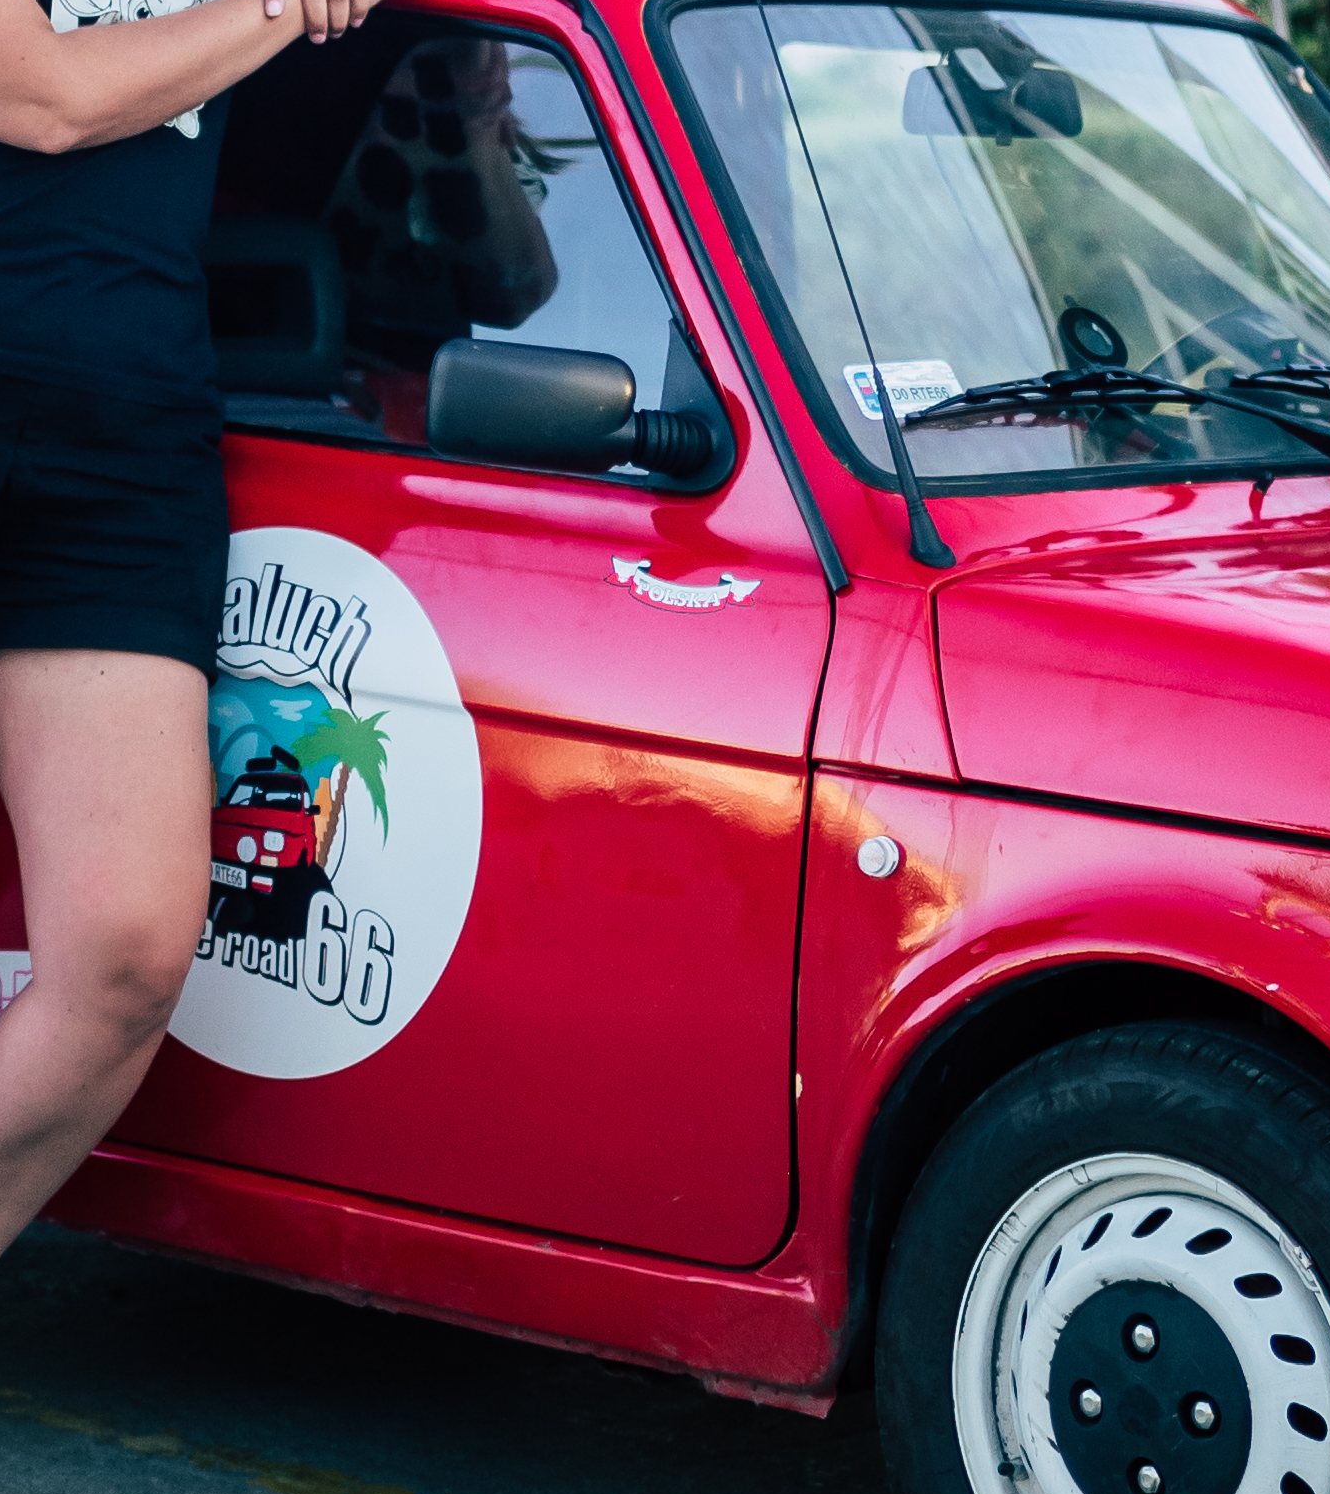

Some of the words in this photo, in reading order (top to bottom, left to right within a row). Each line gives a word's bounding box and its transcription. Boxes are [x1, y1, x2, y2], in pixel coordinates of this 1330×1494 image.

[218, 563, 372, 710] aluch
[634, 577, 722, 608] POLSKA
[221, 932, 298, 991] road
[302, 890, 395, 1026] 66
